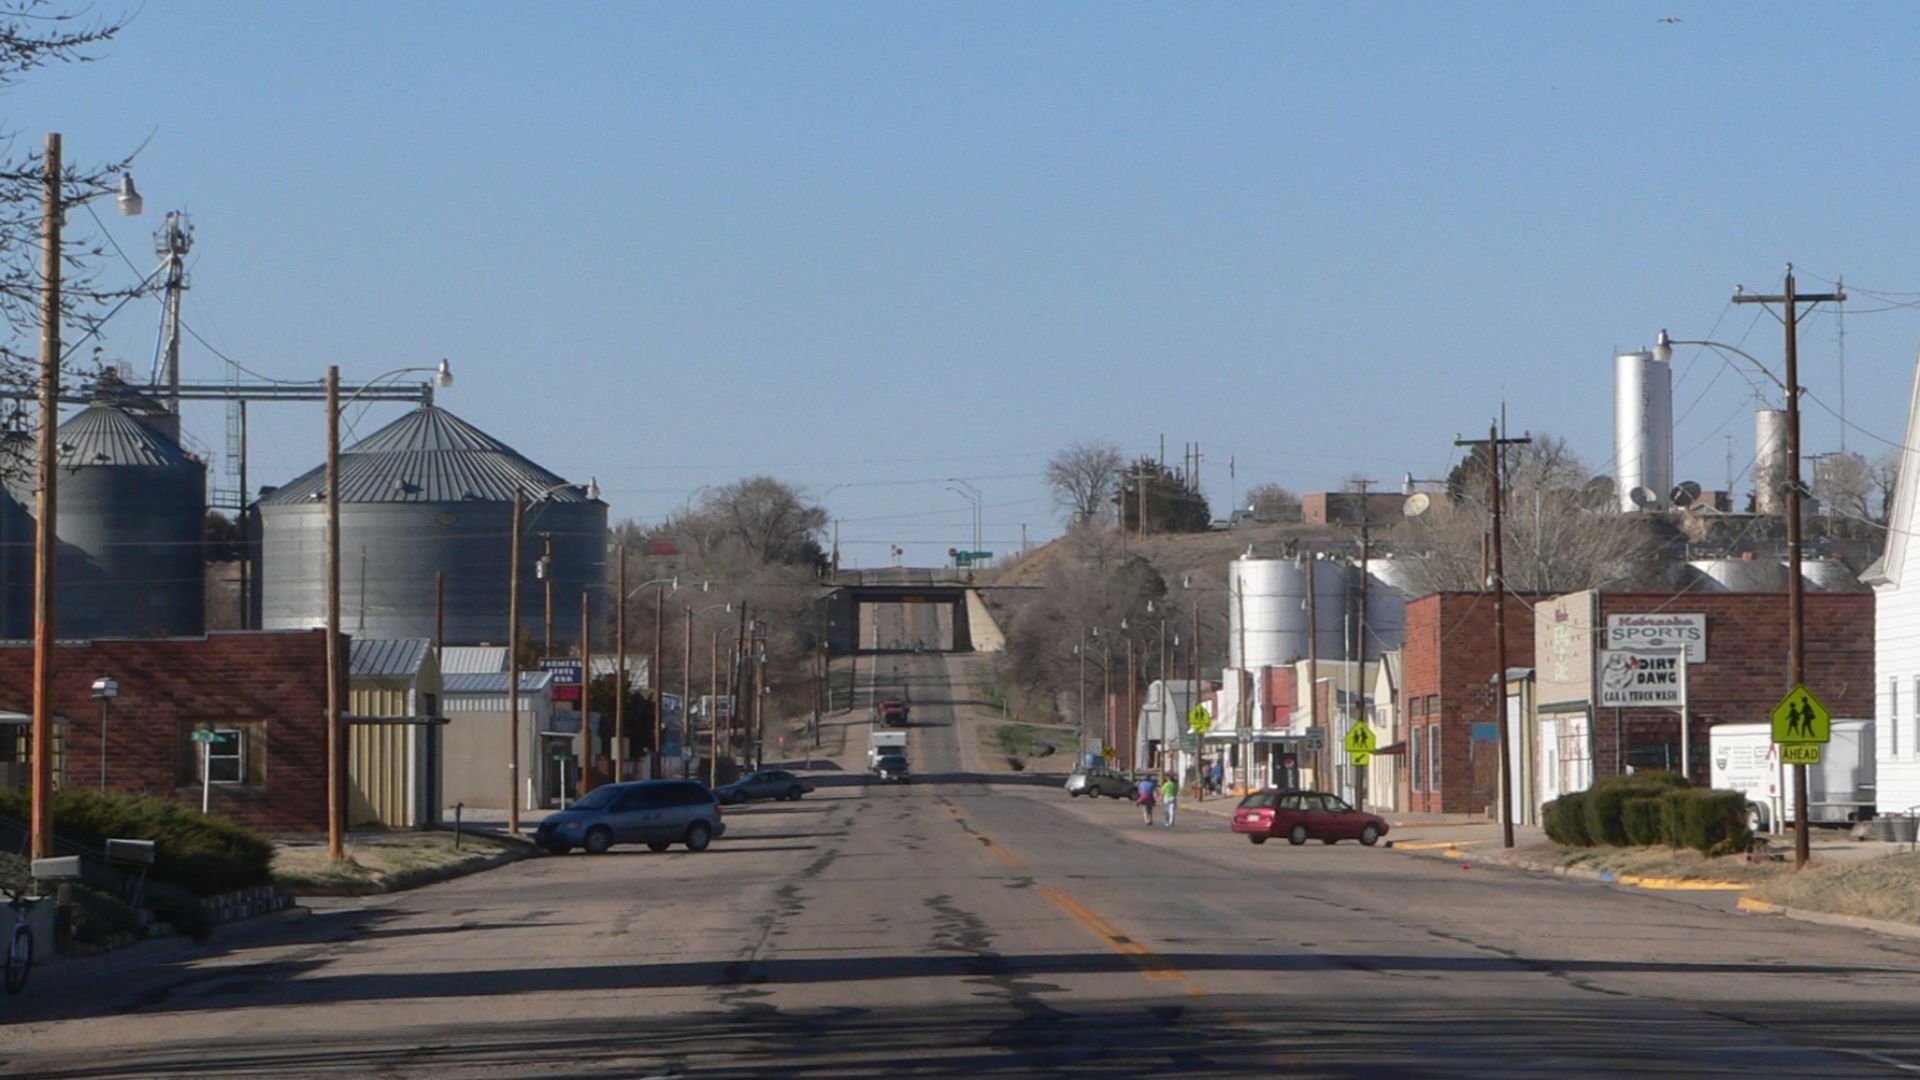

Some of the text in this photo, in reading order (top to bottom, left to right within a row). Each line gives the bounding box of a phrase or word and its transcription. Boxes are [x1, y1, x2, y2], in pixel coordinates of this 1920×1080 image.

[1611, 627, 1701, 641] SPORTS
[1638, 658, 1677, 670] DIRT
[1637, 672, 1677, 684] DAWG
[1604, 691, 1620, 701] CAR
[1629, 690, 1654, 701] TRUCK
[1655, 689, 1677, 700] WASH
[1783, 748, 1818, 760] AHEAD
